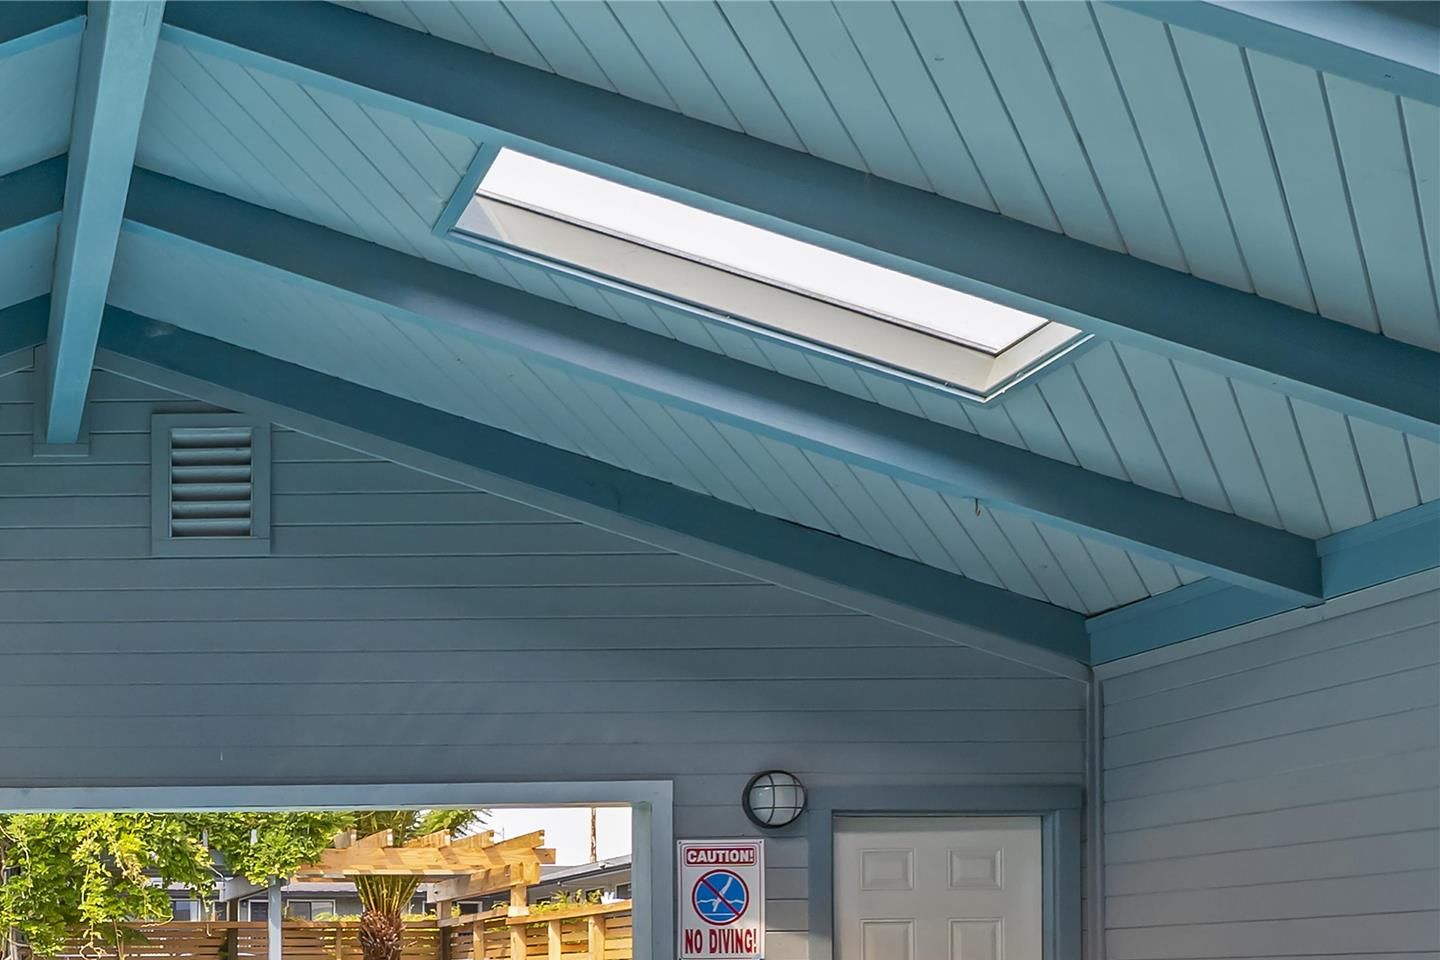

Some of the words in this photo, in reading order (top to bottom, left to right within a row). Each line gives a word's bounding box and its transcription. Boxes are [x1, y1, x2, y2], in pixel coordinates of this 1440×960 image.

[687, 849, 754, 863] CAUTION!
[685, 928, 703, 954] NO
[709, 928, 757, 954] DIVING!
